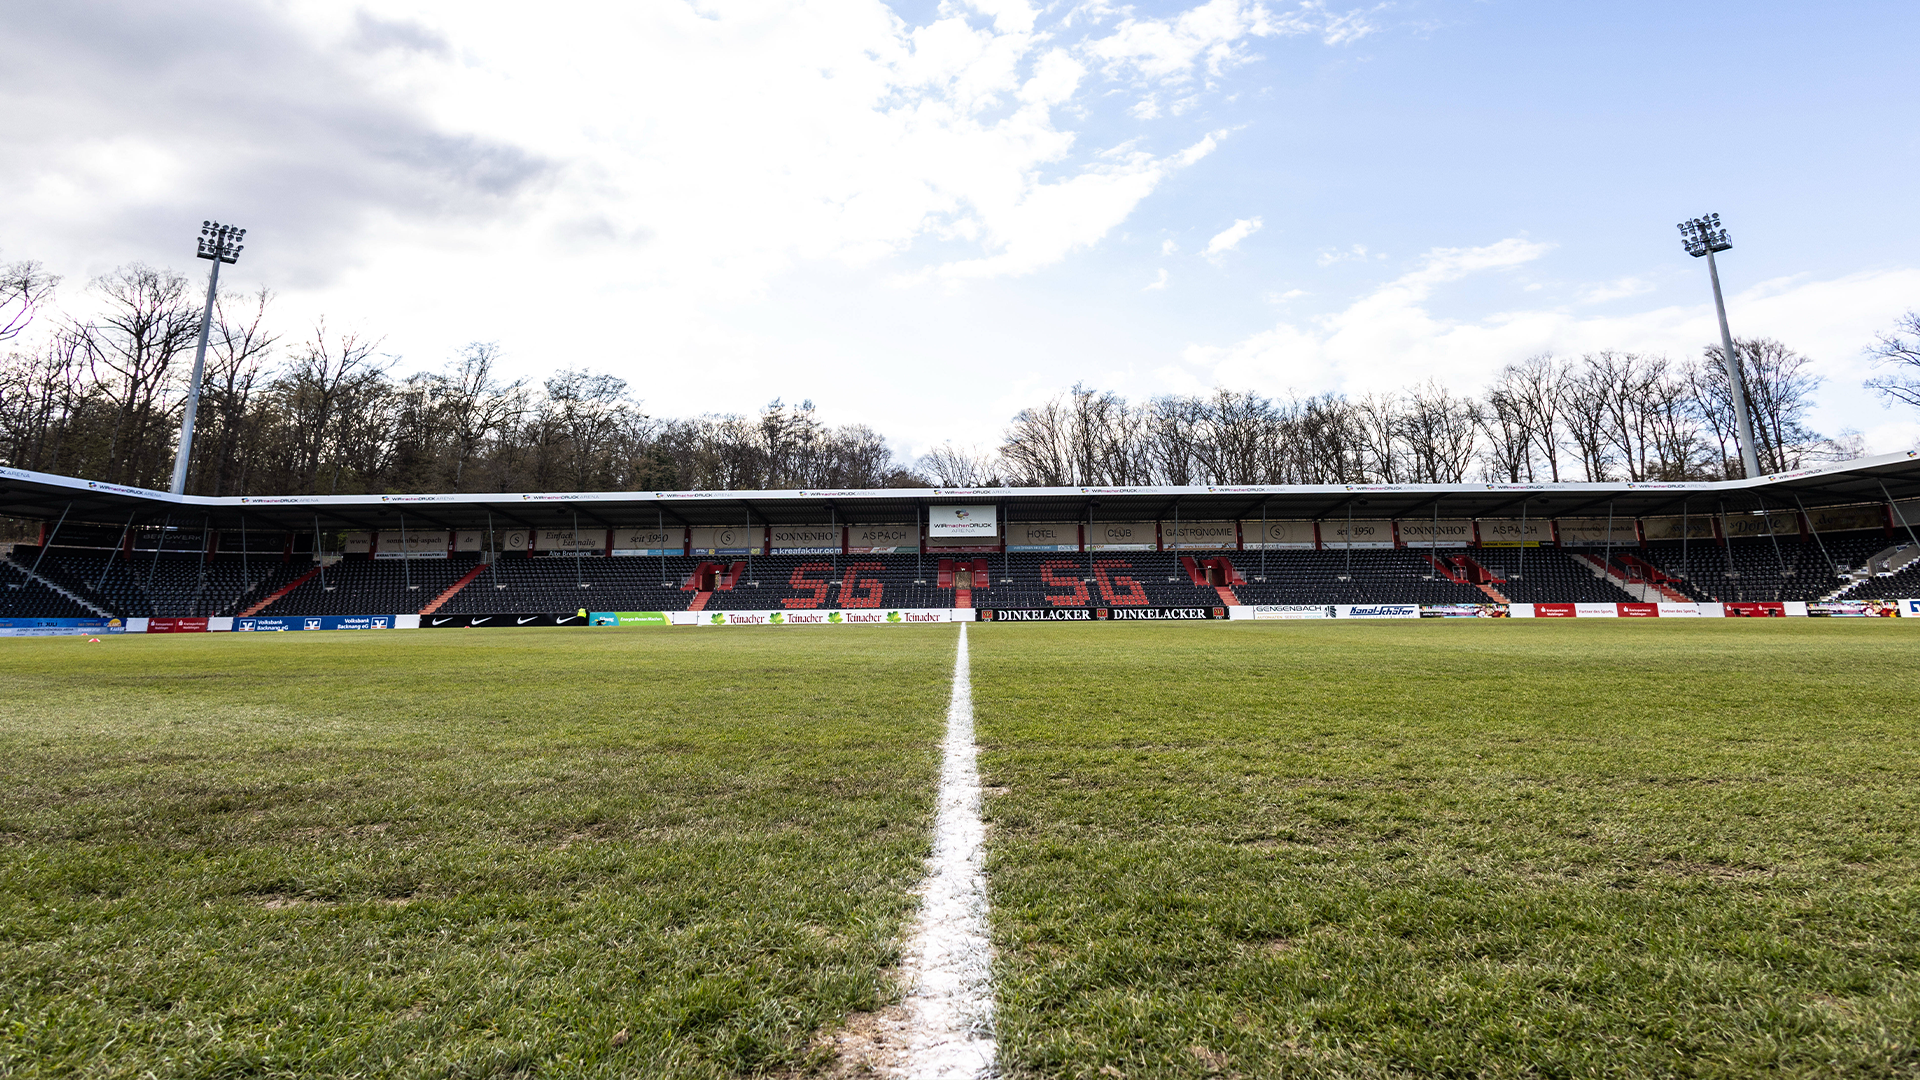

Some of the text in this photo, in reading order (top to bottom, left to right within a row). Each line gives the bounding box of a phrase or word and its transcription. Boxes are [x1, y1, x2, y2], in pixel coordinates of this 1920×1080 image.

[7, 470, 31, 479] ARENA
[1027, 530, 1057, 539] HOTEL
[1107, 529, 1132, 538] CLUB
[1165, 528, 1233, 537] GASTRONOMIE
[1336, 526, 1375, 536] sei 1950
[1403, 526, 1468, 536] SONNENHOF
[1492, 525, 1538, 535] ASPACH
[142, 533, 202, 542] BERGWERK
[545, 531, 574, 541] Einfach
[630, 534, 645, 543] seit
[775, 532, 840, 542] SONNENHOF
[861, 531, 907, 541] ASPACH
[779, 547, 843, 555] kreafaktur.com
[998, 609, 1091, 621] DINKELACKER
[1113, 608, 1207, 620] DINKELACKER
[1349, 605, 1415, 616] Kanal-Schäfer
[728, 613, 765, 625] Teinacher
[787, 612, 824, 624] Teinacher
[846, 612, 882, 623] Teinacher
[904, 611, 941, 623] Teinacher
